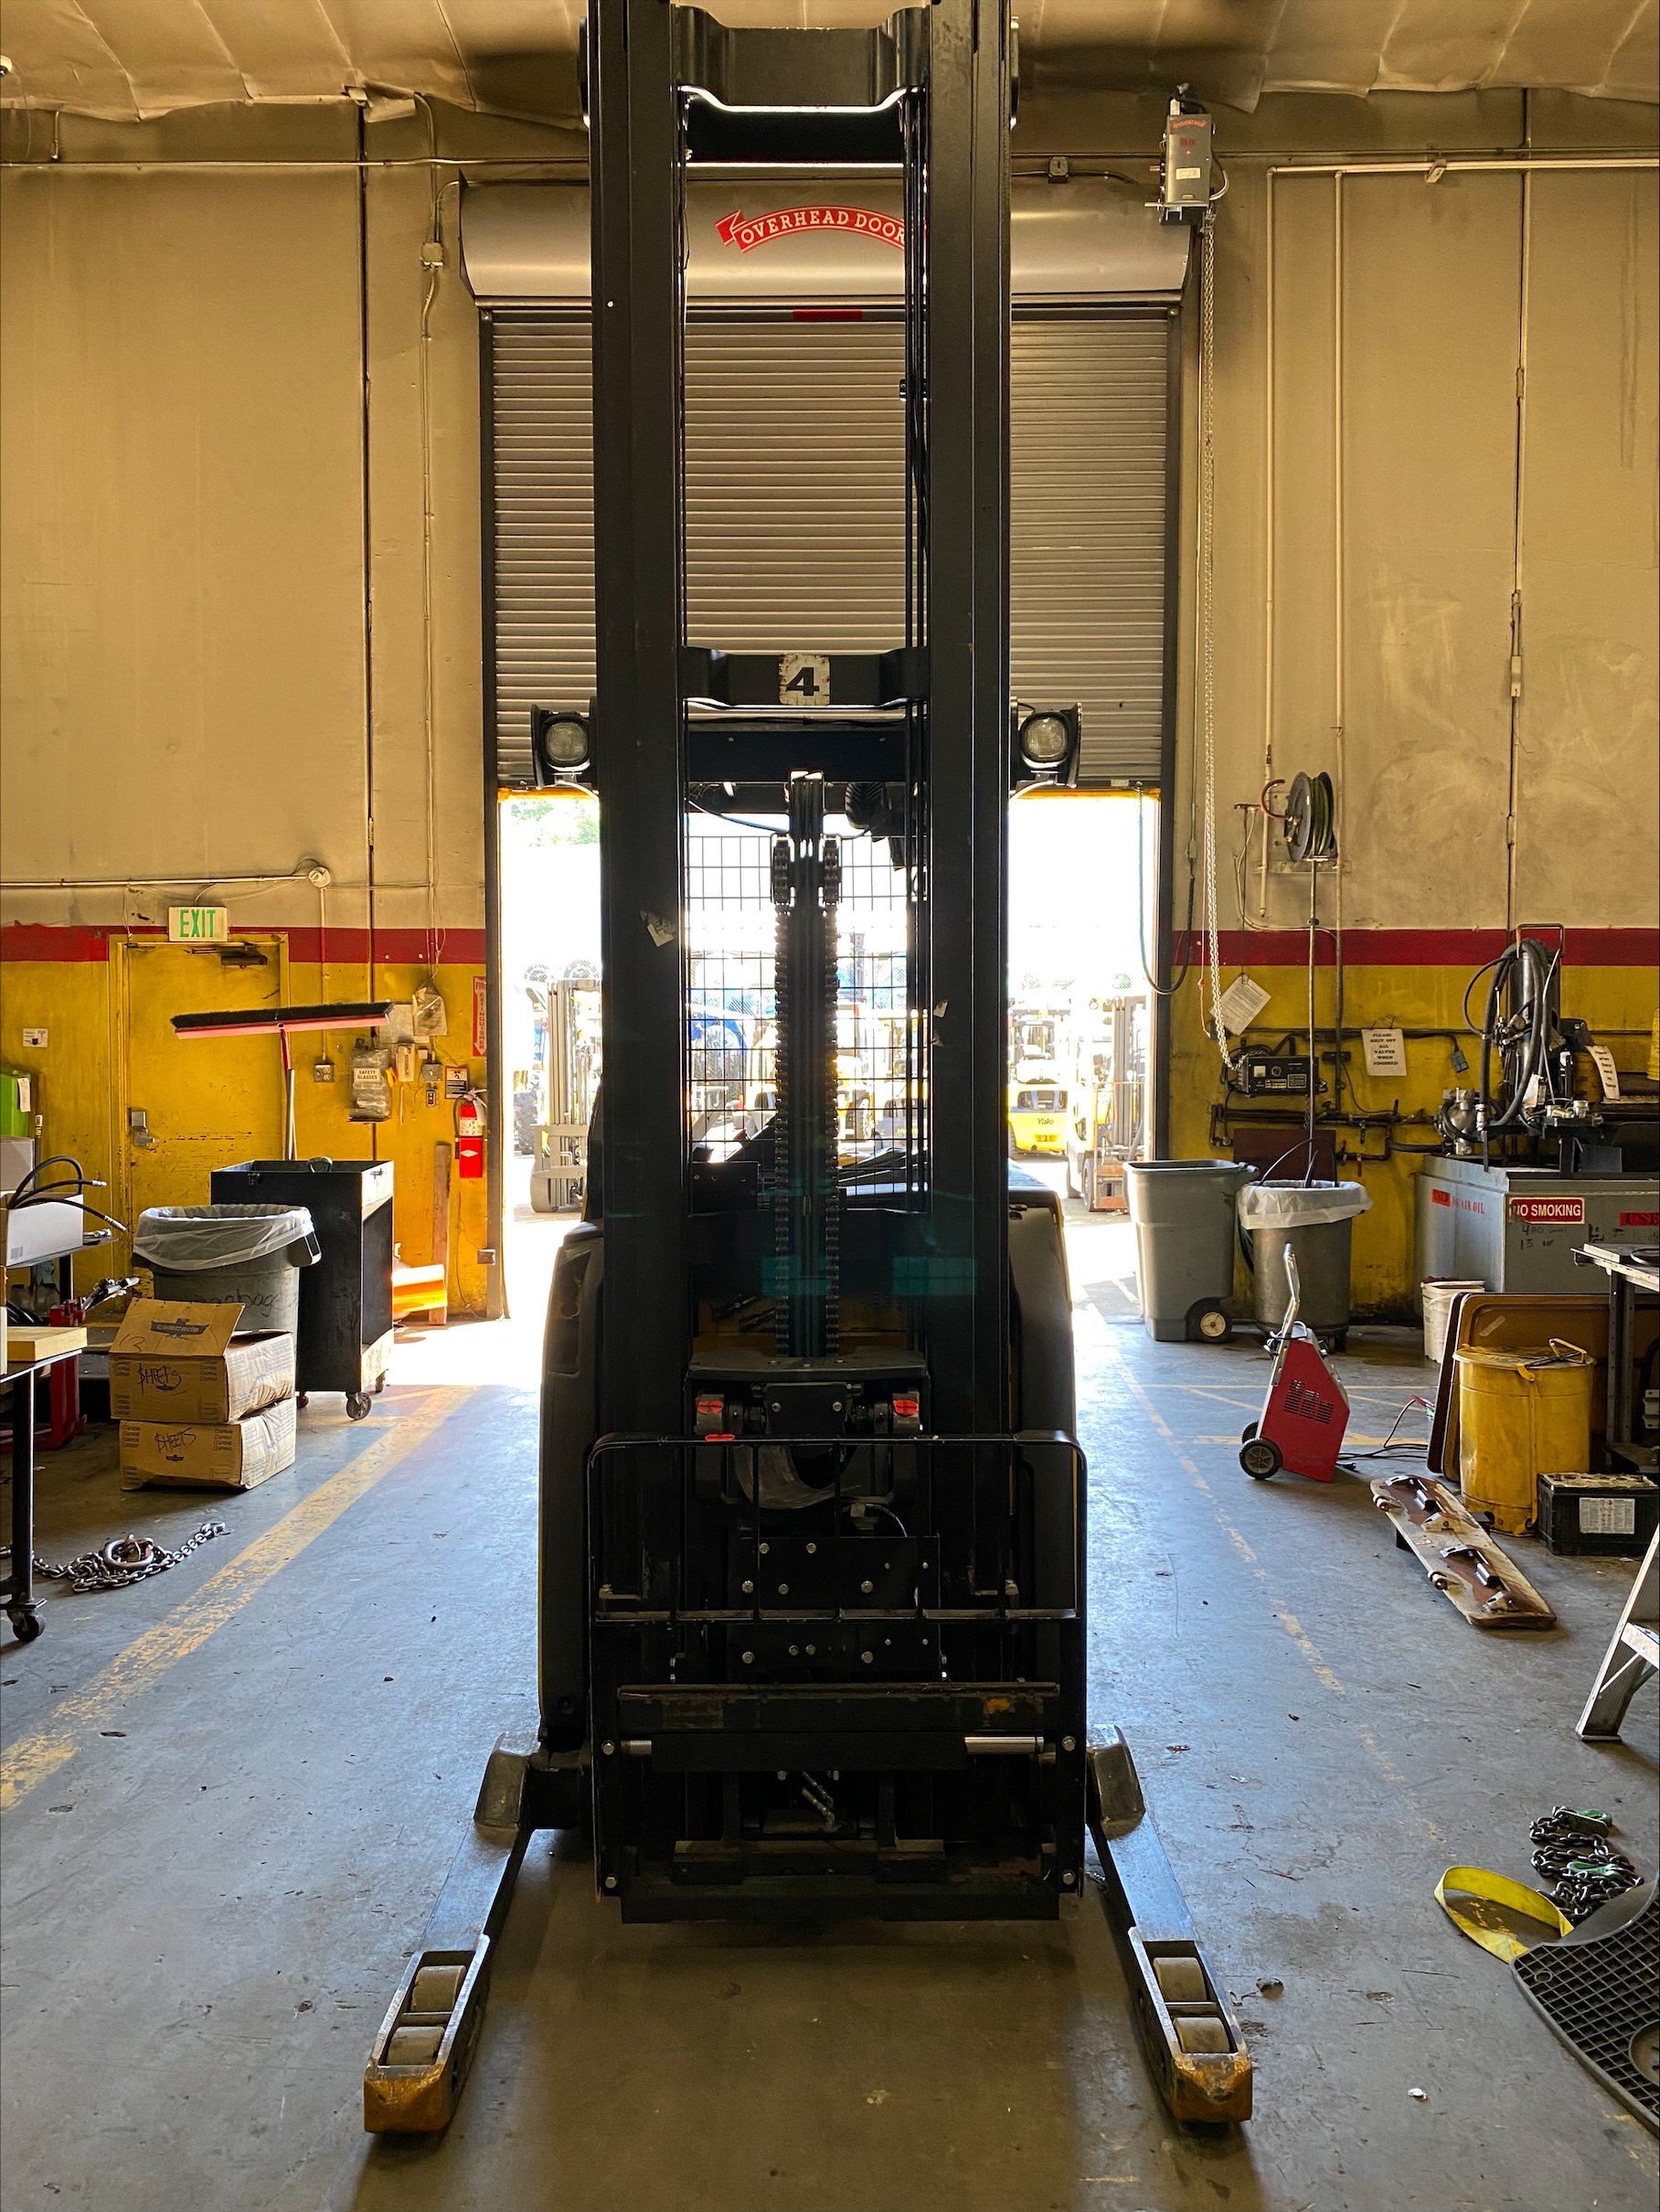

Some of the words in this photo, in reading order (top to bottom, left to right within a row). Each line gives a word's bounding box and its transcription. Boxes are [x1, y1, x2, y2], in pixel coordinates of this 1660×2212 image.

[740, 209, 849, 244] OVERHEAD
[786, 666, 820, 697] 4
[180, 909, 216, 938] EXIT
[1473, 1201, 1484, 1215] OIL
[1530, 1204, 1581, 1217] SMOKING
